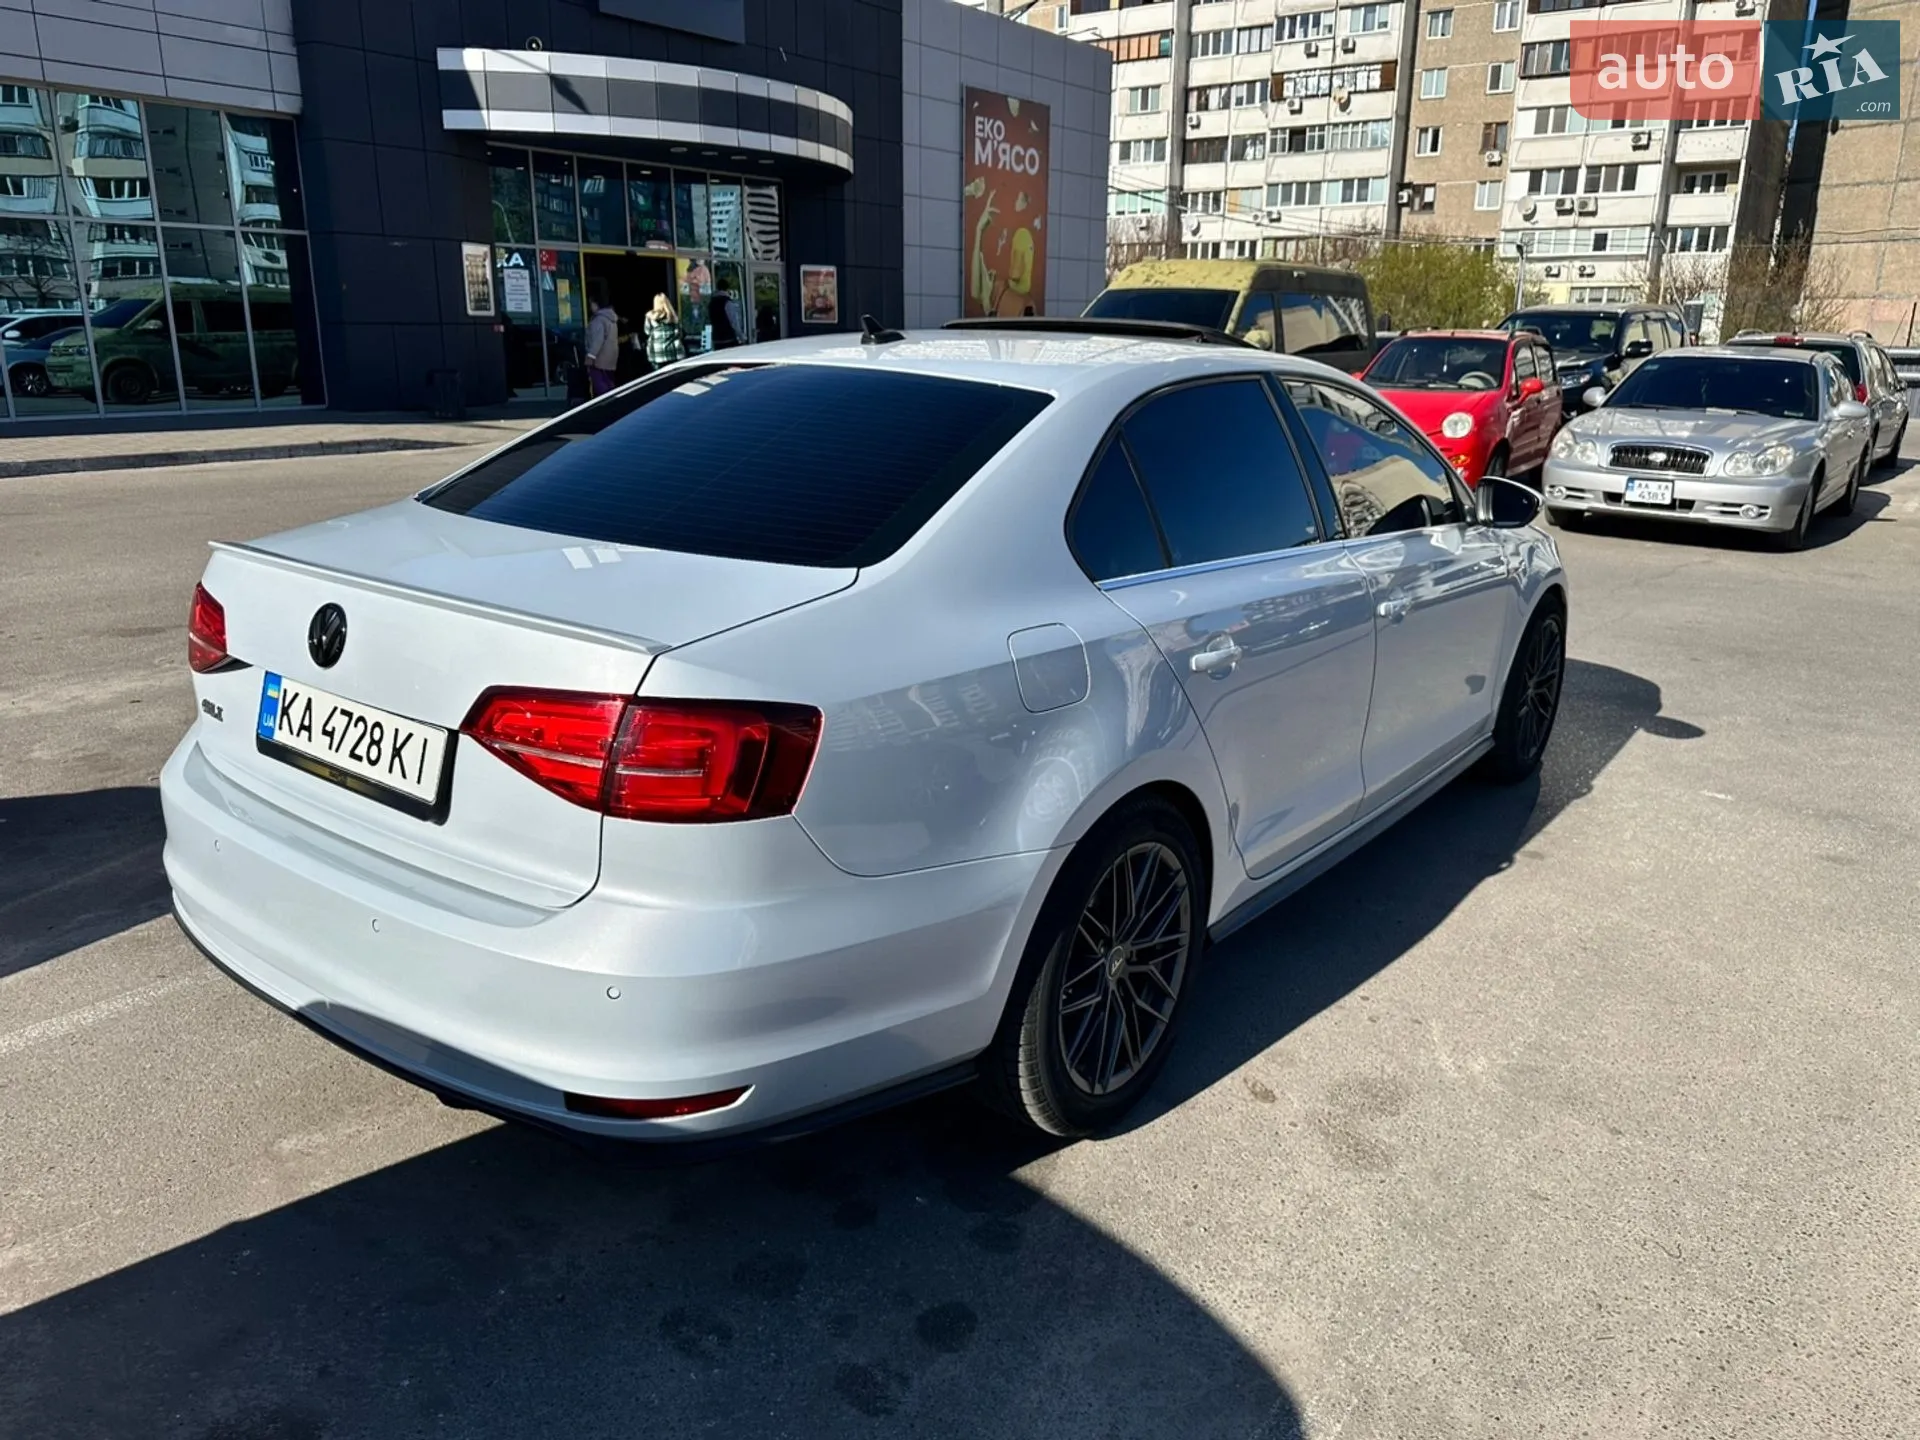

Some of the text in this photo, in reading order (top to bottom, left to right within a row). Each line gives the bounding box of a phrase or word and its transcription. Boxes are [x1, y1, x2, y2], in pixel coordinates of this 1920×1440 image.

[974, 115, 1006, 142] ЕКО
[974, 137, 1040, 176] М'ЯСО
[278, 688, 428, 785] KA 4728 KI
